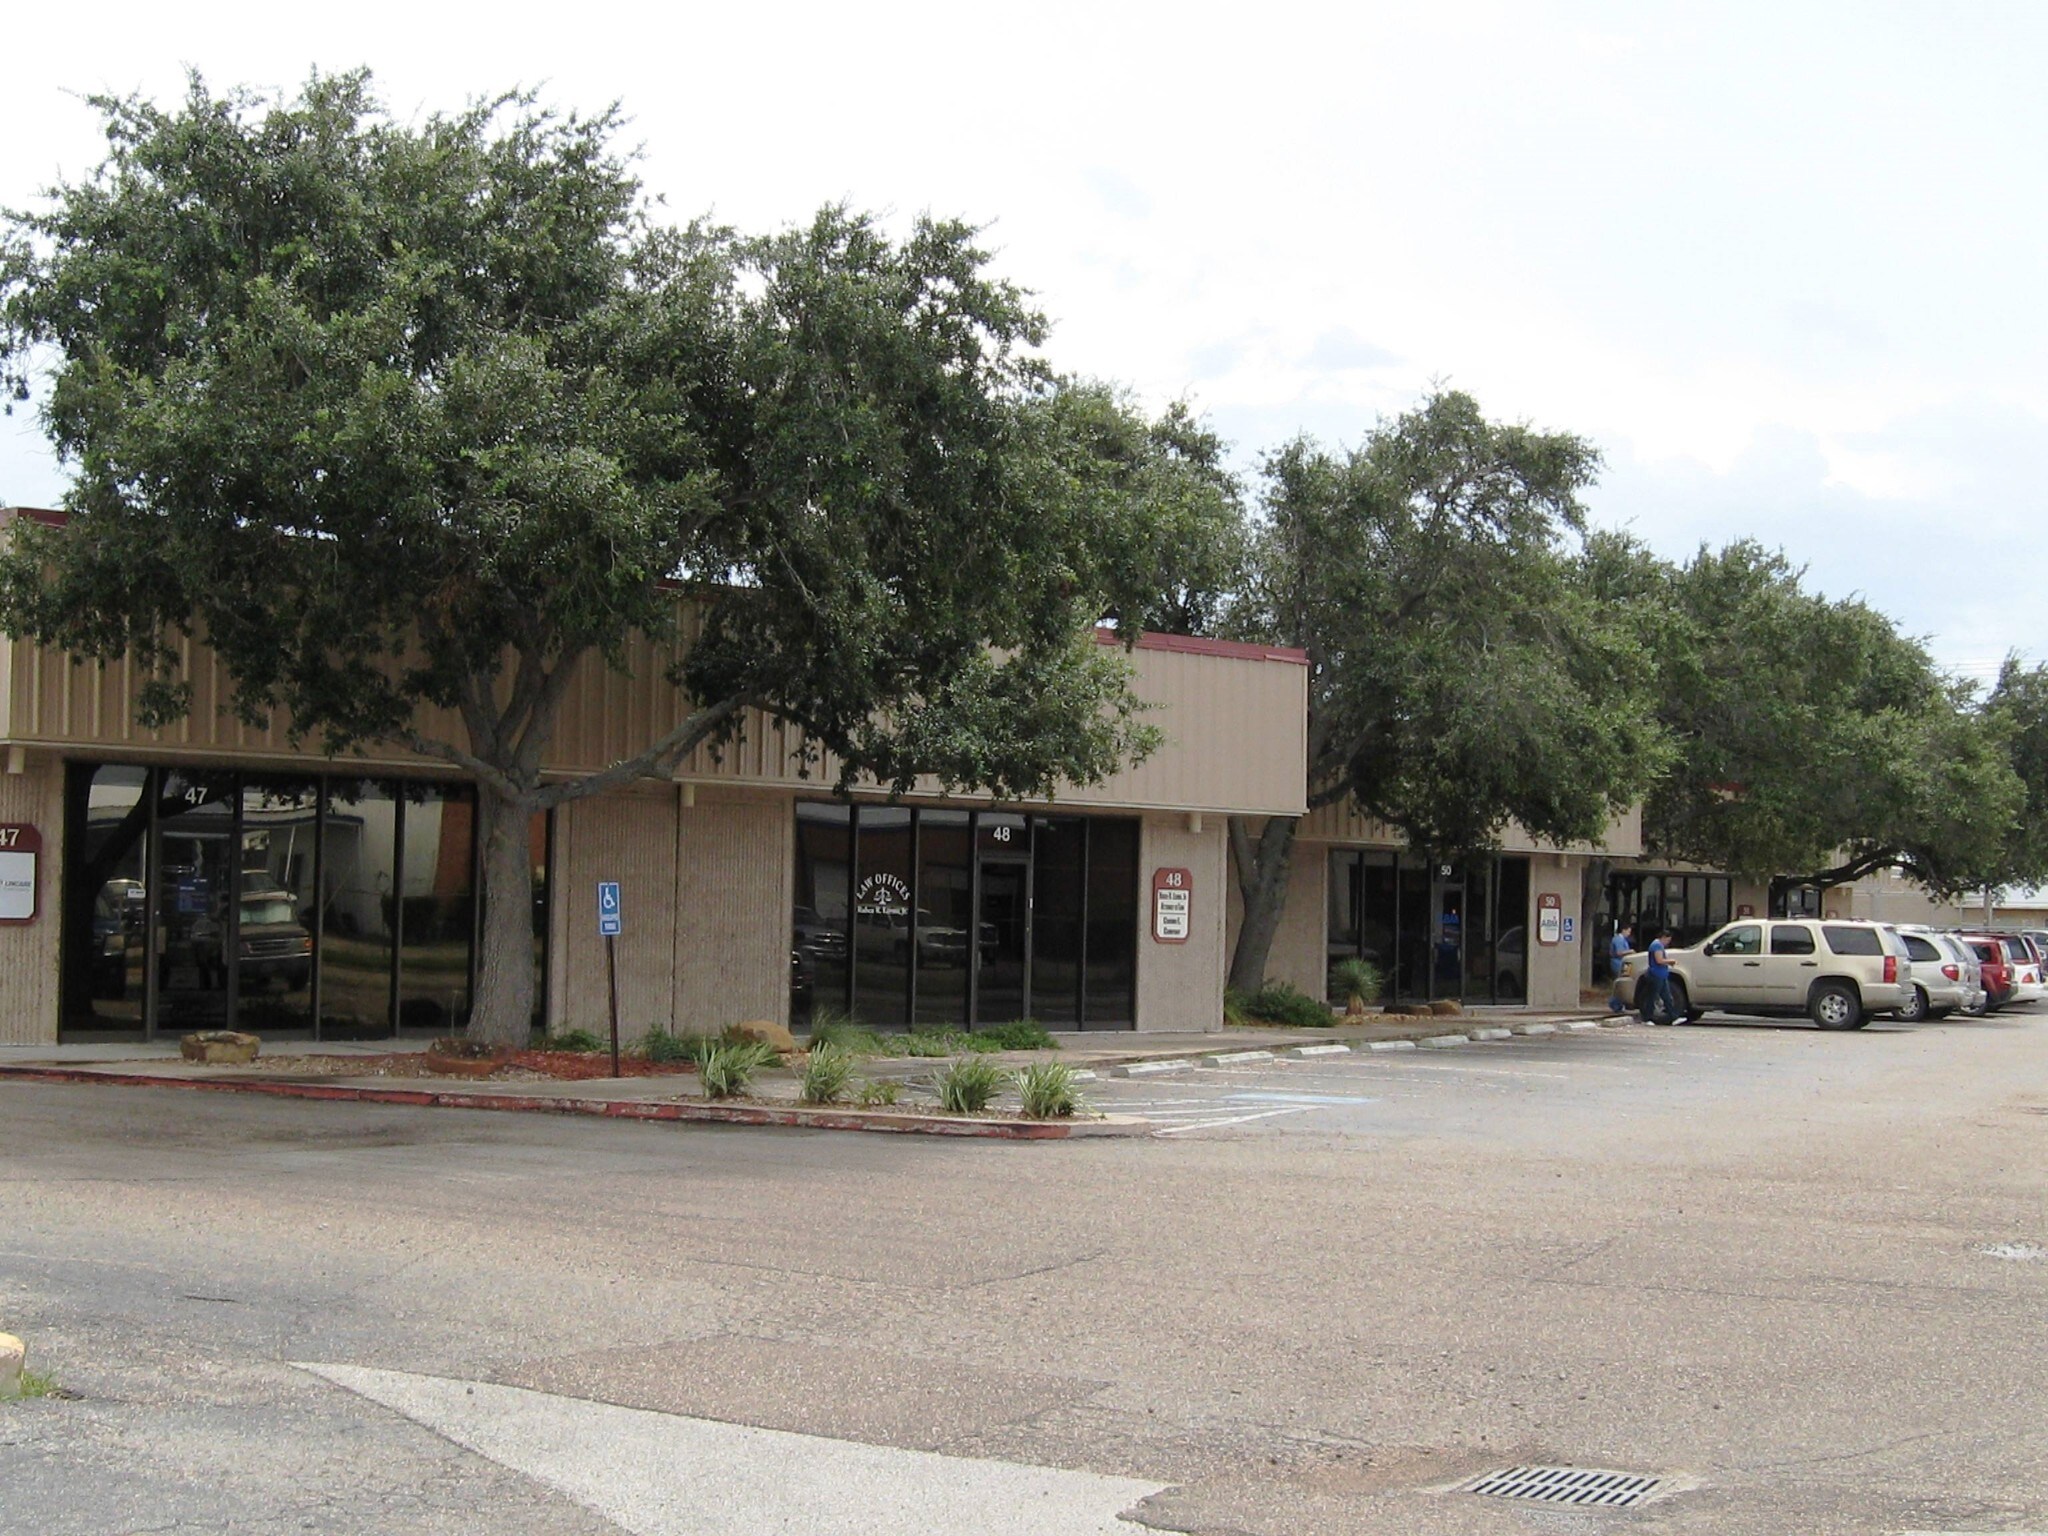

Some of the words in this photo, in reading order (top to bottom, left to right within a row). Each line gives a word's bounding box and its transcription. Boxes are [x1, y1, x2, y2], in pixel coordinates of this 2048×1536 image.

[184, 787, 208, 804] 47
[993, 826, 1011, 841] 48
[1441, 865, 1452, 875] 50
[856, 876, 874, 900] LAW
[875, 873, 910, 900] OFFICES
[1165, 872, 1182, 887] 48
